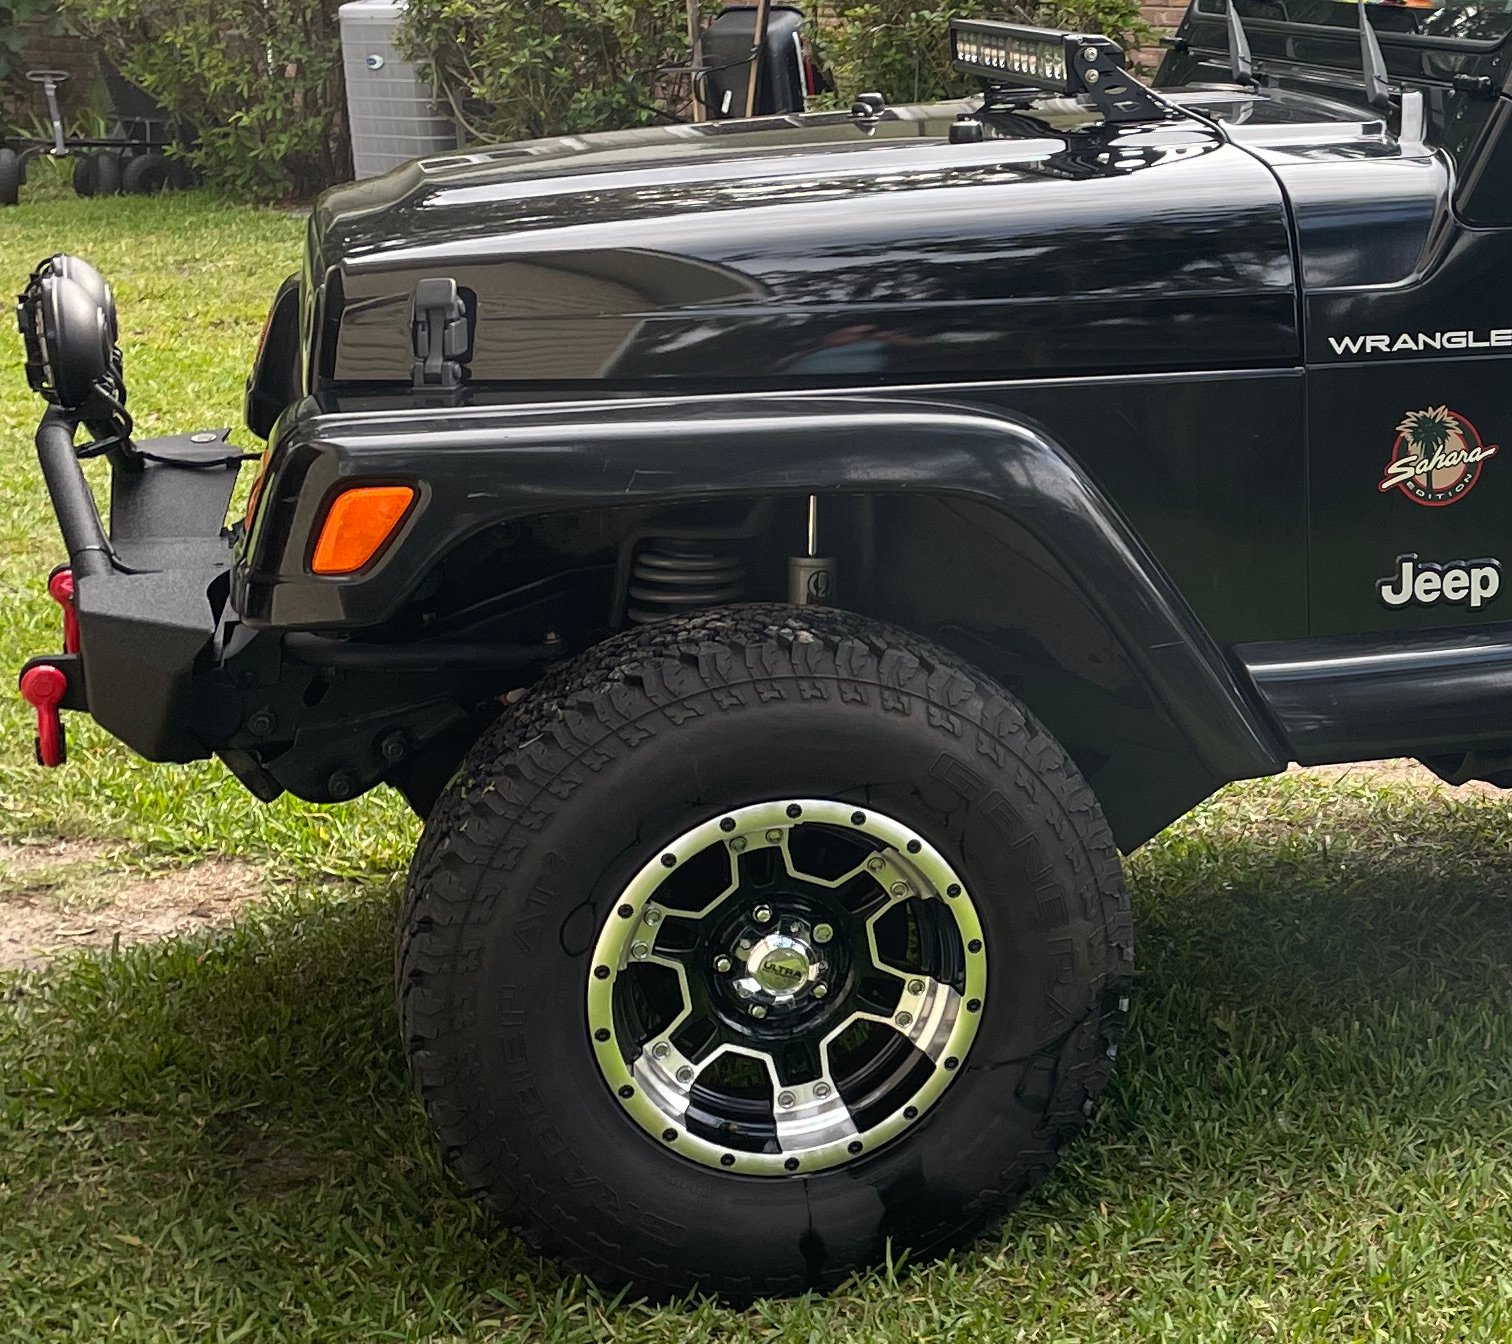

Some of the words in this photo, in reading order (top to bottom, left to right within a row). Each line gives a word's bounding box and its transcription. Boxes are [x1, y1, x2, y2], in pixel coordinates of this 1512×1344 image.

[1381, 445, 1496, 490] Sahara
[1406, 473, 1473, 501] EDITION
[1381, 561, 1500, 607] Jeep
[763, 961, 802, 978] ULTRA
